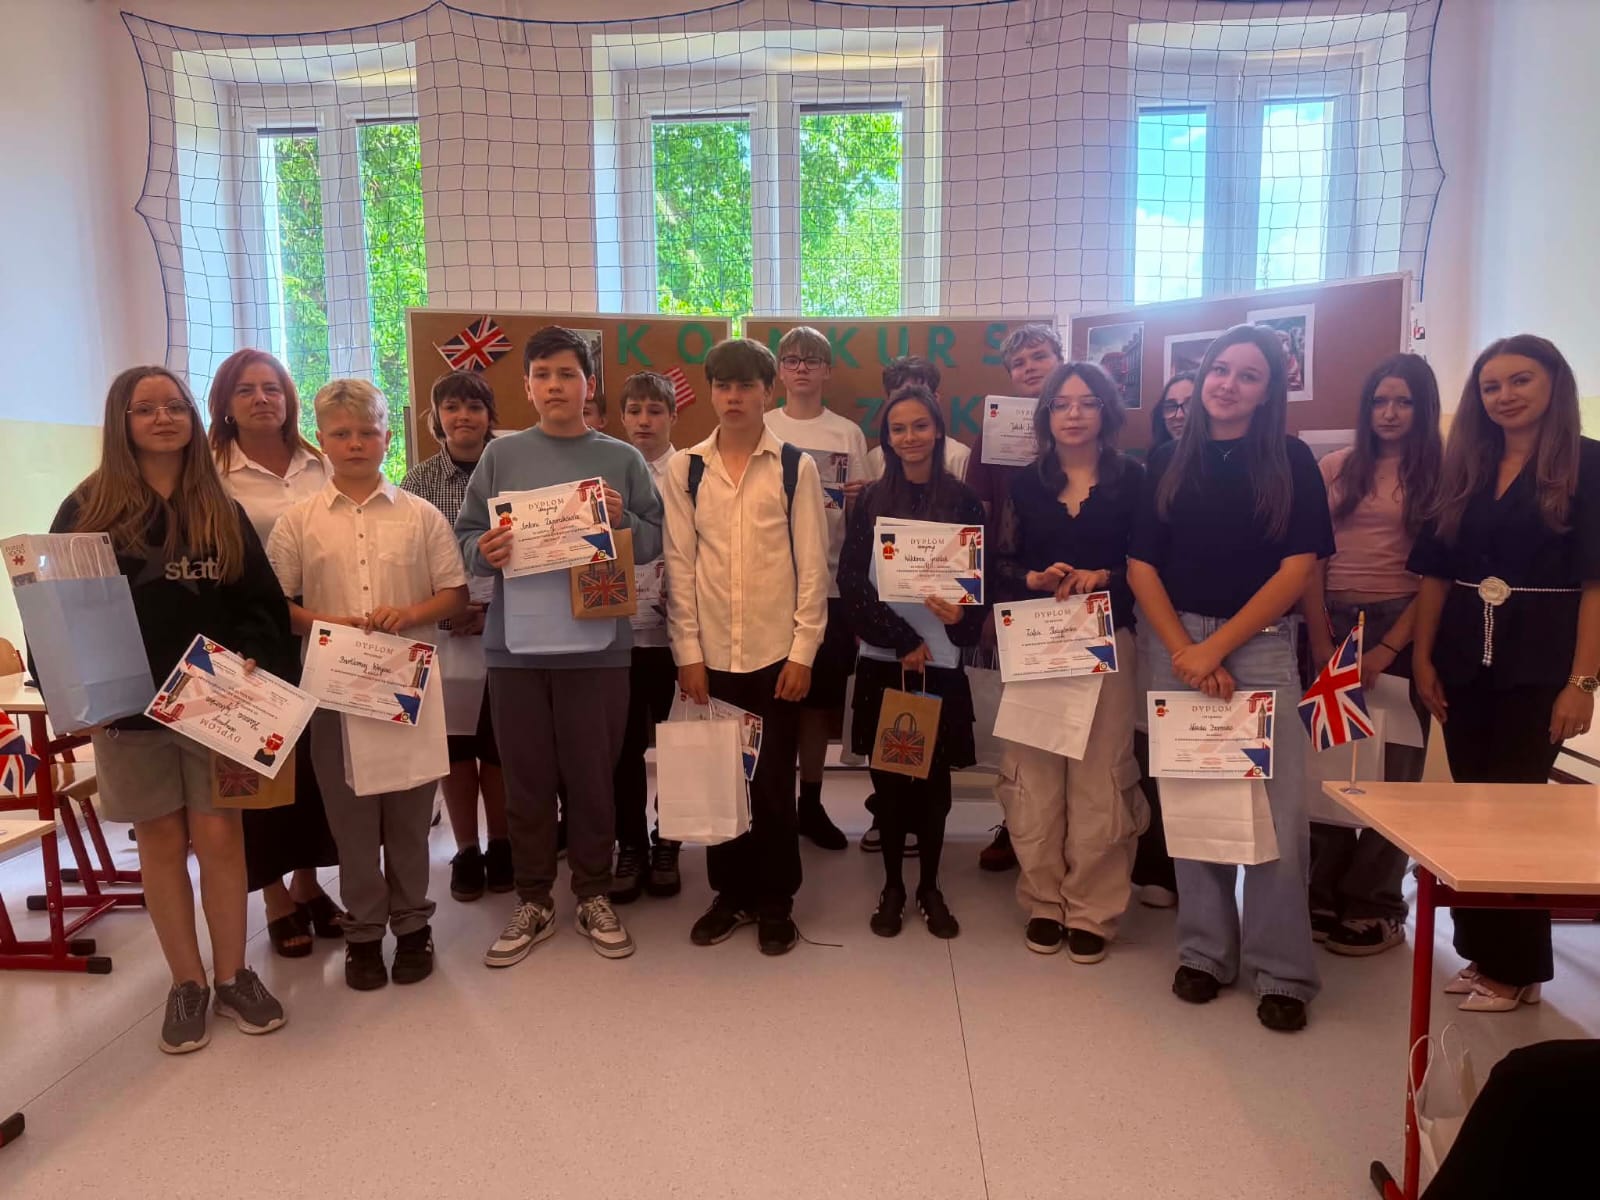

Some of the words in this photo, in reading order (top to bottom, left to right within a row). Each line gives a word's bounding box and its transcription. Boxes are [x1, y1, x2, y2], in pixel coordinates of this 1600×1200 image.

[528, 497, 565, 510] DYPLOM
[1034, 609, 1072, 619] DYPLOM
[355, 640, 394, 655] DYPLOM
[1191, 705, 1232, 713] DYPLOM
[200, 718, 241, 743] DYPLOM
